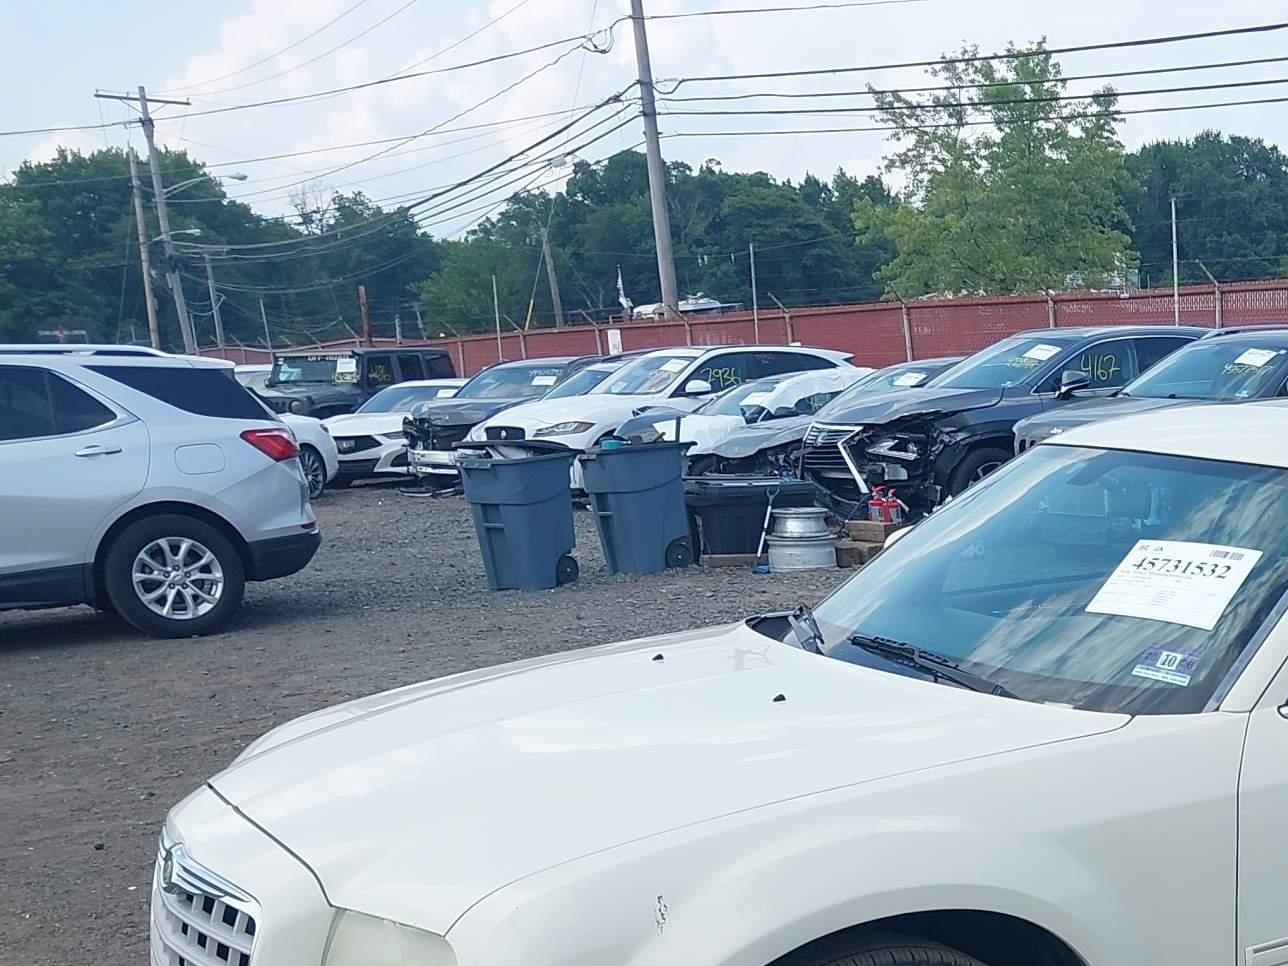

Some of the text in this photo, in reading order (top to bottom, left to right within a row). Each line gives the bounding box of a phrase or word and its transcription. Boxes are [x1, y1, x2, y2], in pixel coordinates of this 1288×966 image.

[1080, 353, 1120, 382] 4167
[1132, 556, 1231, 579] 45731532
[1160, 653, 1178, 668] 10
